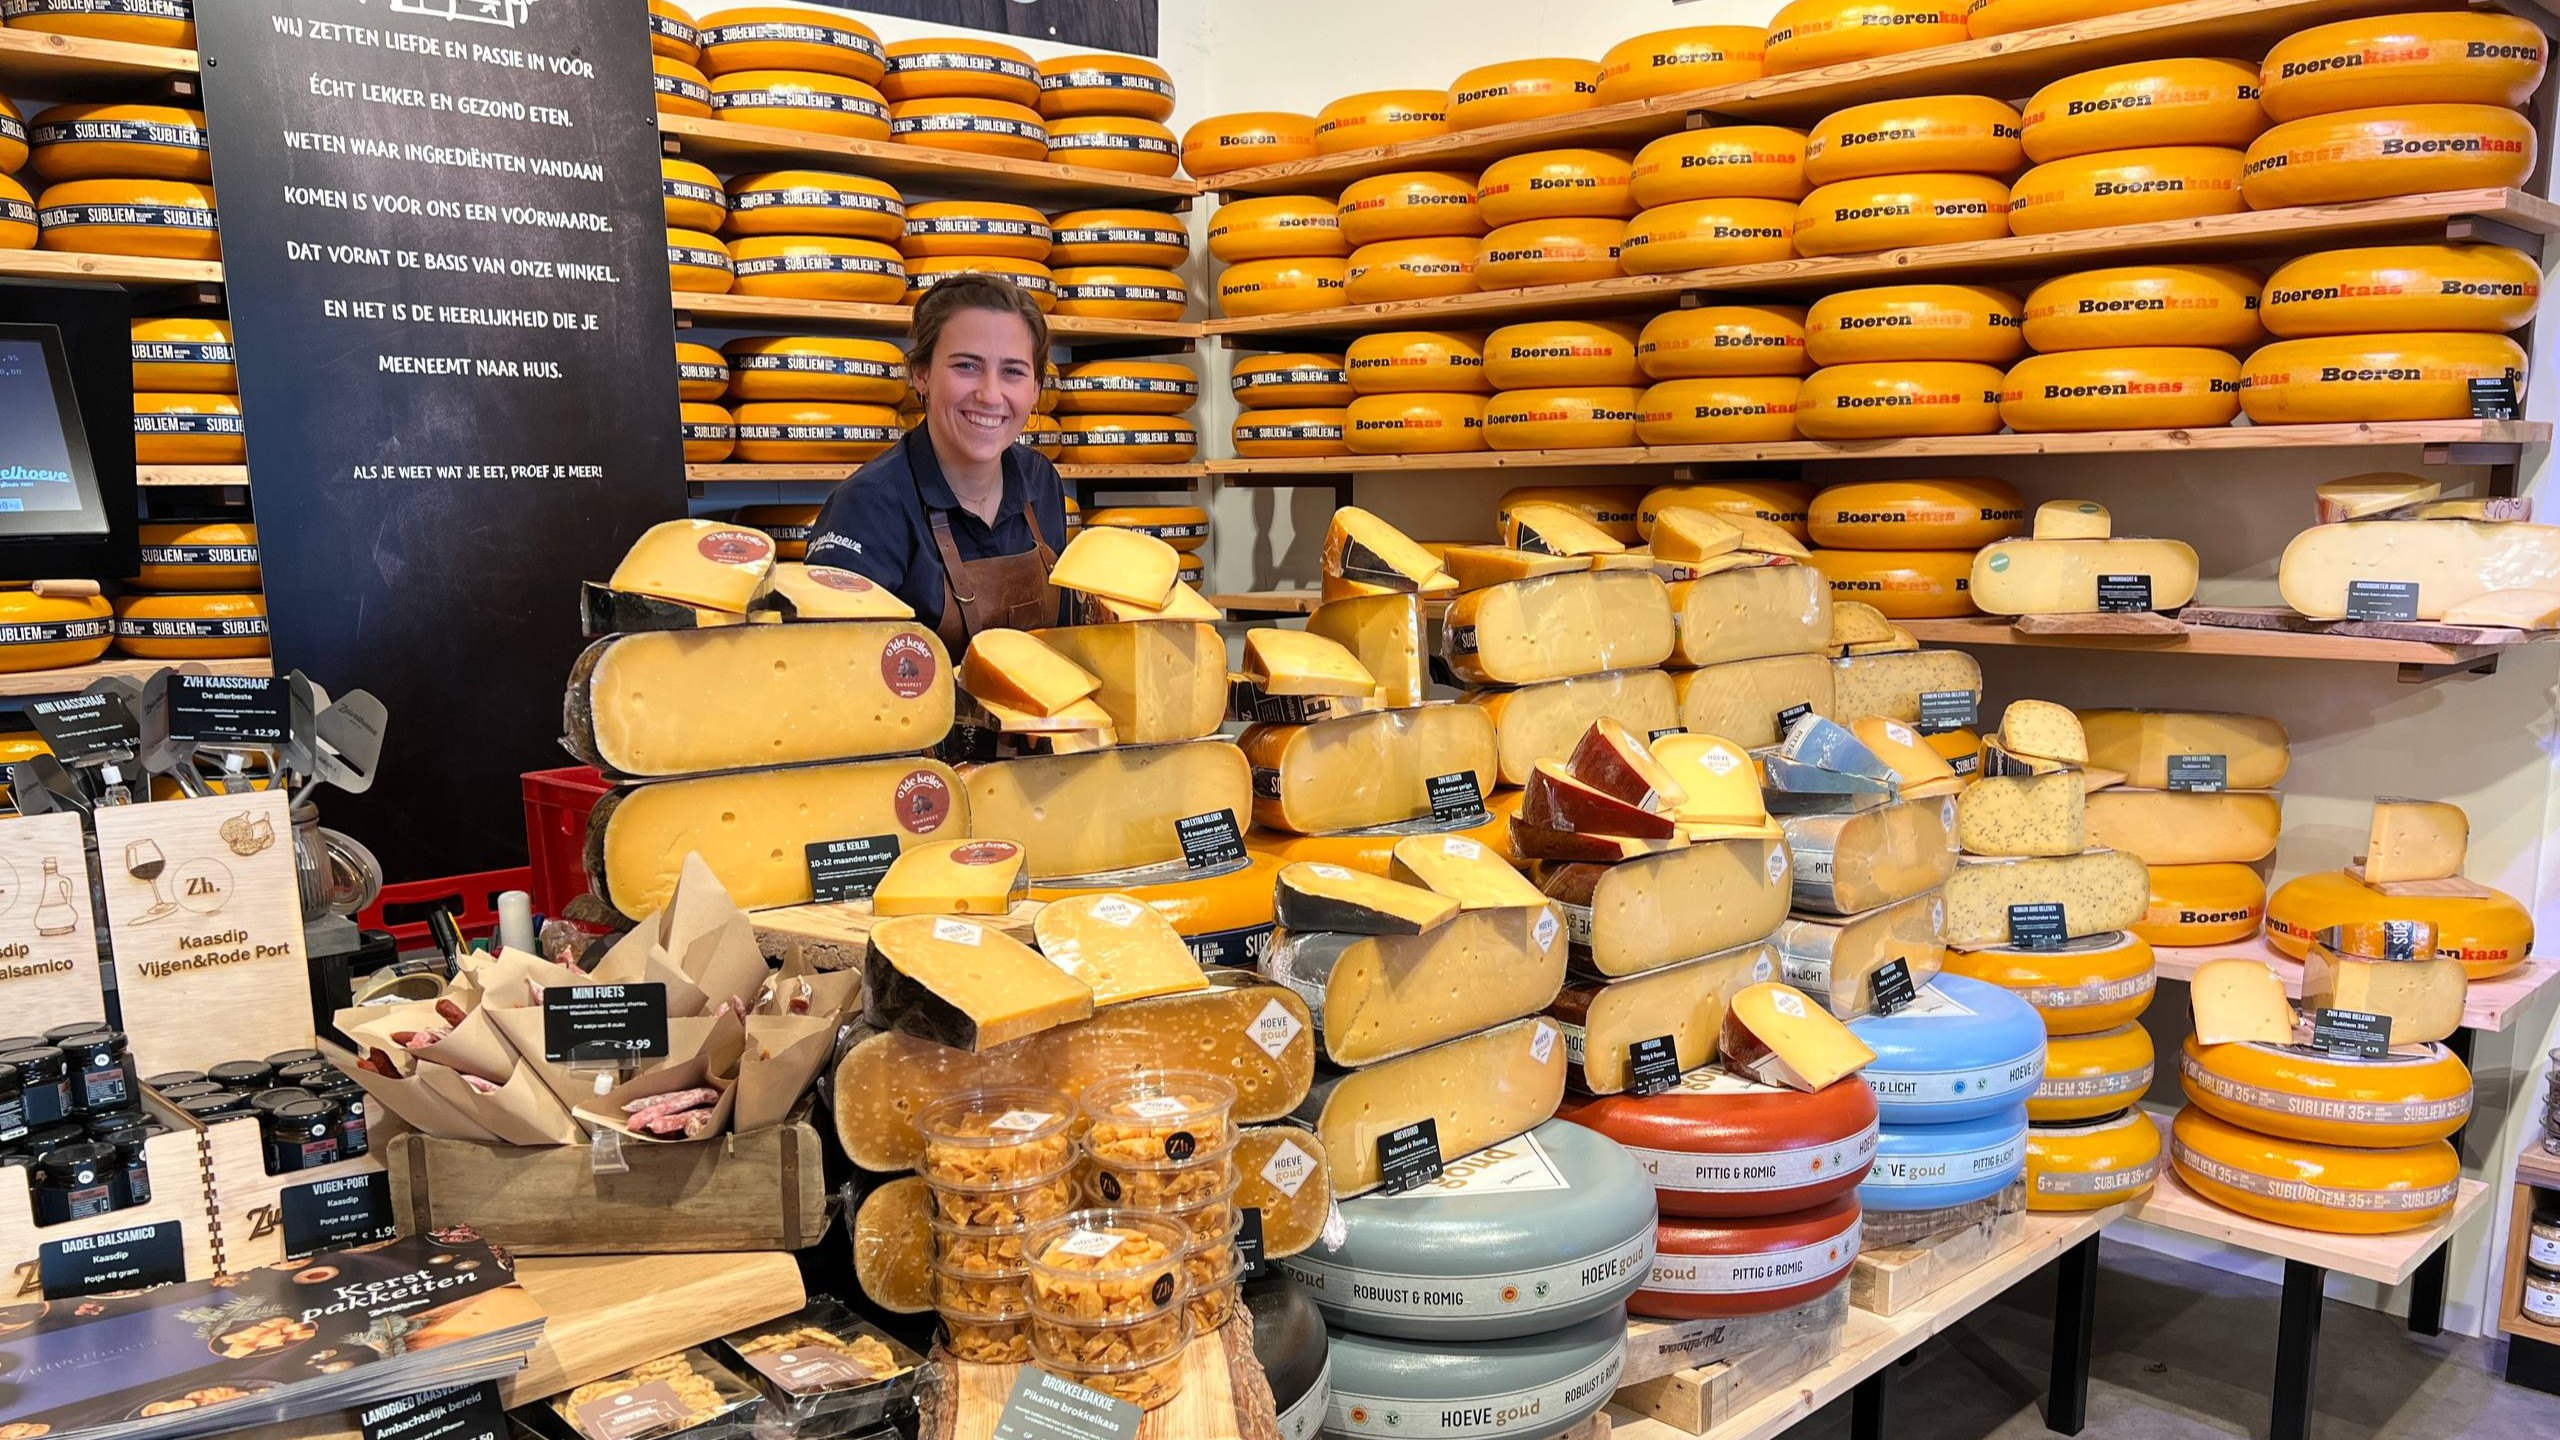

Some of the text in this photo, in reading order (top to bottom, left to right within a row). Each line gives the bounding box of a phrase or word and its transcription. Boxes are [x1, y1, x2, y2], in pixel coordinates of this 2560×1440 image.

[272, 15, 594, 79] WIJ ZETTEN LIEFDE EN PASSIE IN VOOR
[310, 72, 574, 128] ÉCHT LEKKER EN GEZOND ETEN.
[733, 93, 766, 107] SUBLIEM
[75, 124, 121, 139] SUBLIEM
[2382, 135, 2522, 156] Boerenkaas
[283, 130, 603, 182] WETEN WAAR INGREDIËNTEN VANDAAN
[163, 210, 213, 227] SUBLIEM
[283, 186, 613, 233] KOMEN IS VOOR ONS EEN VOORWAARDE.
[935, 220, 970, 233] SUBLIEM
[286, 241, 620, 283] DAT VORMT DE BASIS VAN ONZE WINKEL.
[2271, 283, 2402, 305] Boerenkaas
[324, 300, 599, 331] EN HET IS DE HEERLIJKHEID DIE JE
[1511, 344, 1612, 359] Boerenkaas
[378, 355, 563, 379] MEENEEMT NAAR HUIS.
[788, 356, 824, 372] SUBLIEM
[1350, 355, 1428, 369] Boerenkaas
[2044, 379, 2182, 399] Boerenkaas
[1837, 391, 1961, 409] Boerenkaas
[1487, 409, 1568, 426] Boerenkaas
[353, 465, 602, 481] ALS JE WEET WAT JE EET, PROEF JE MEER!
[183, 676, 270, 690] ZVH KAASSCHAAF
[34, 694, 107, 715] MINI KAASSCHAAF
[58, 710, 100, 723] Super scherp
[1192, 827, 1214, 837] maanden
[828, 840, 870, 853] OLDE KEILER
[810, 851, 892, 868] 10-12 maanden gerijpt
[179, 929, 249, 951] Kaasdip
[1202, 942, 1219, 950] EXTRA
[138, 941, 290, 978] Vijgen&Rode Port
[572, 985, 625, 999] MINI FUETS
[2099, 980, 2135, 1001] SUBLIEM
[1260, 1017, 1288, 1030] HOEVE
[1260, 1028, 1288, 1042] goud
[2009, 1062, 2032, 1082] HOEVE
[1888, 1081, 1916, 1094] LICHT
[2198, 1072, 2257, 1103] SUBLIEM 35+
[2288, 1097, 2373, 1120] SUBLIEM 35+
[1274, 1154, 1302, 1170] HOEVE
[1275, 1167, 1304, 1183] goud
[1696, 1165, 1776, 1179] PITTIG & ROMIG
[1909, 1163, 1946, 1180] goud
[312, 1175, 369, 1196] VIJGEN-PORT
[327, 1196, 359, 1207] Kaasdip
[320, 1217, 339, 1226] Potje
[350, 1212, 369, 1222] gram
[61, 1226, 156, 1254] DADEL BALSAMICO
[92, 1250, 129, 1264] Kaasdip
[1581, 1247, 1644, 1286] HOEVE goud
[1652, 1266, 1696, 1282] goud
[1732, 1261, 1803, 1280] PITTIG & ROMIG
[84, 1268, 140, 1284] Potje 48 gram
[333, 1269, 433, 1300] Kerst
[301, 1271, 478, 1324] pakketten
[1354, 1283, 1464, 1306] ROBUUST & ROMIG
[1041, 1374, 1116, 1412] BROKKELBAKKIE
[361, 1396, 416, 1427] LANDGOED
[376, 1405, 447, 1440] Ambachtelijk
[448, 1391, 482, 1412] bereid
[1022, 1388, 1060, 1410] Pikante
[1060, 1401, 1120, 1432] brokkelkaas
[1441, 1397, 1541, 1428] HOEVE goud
